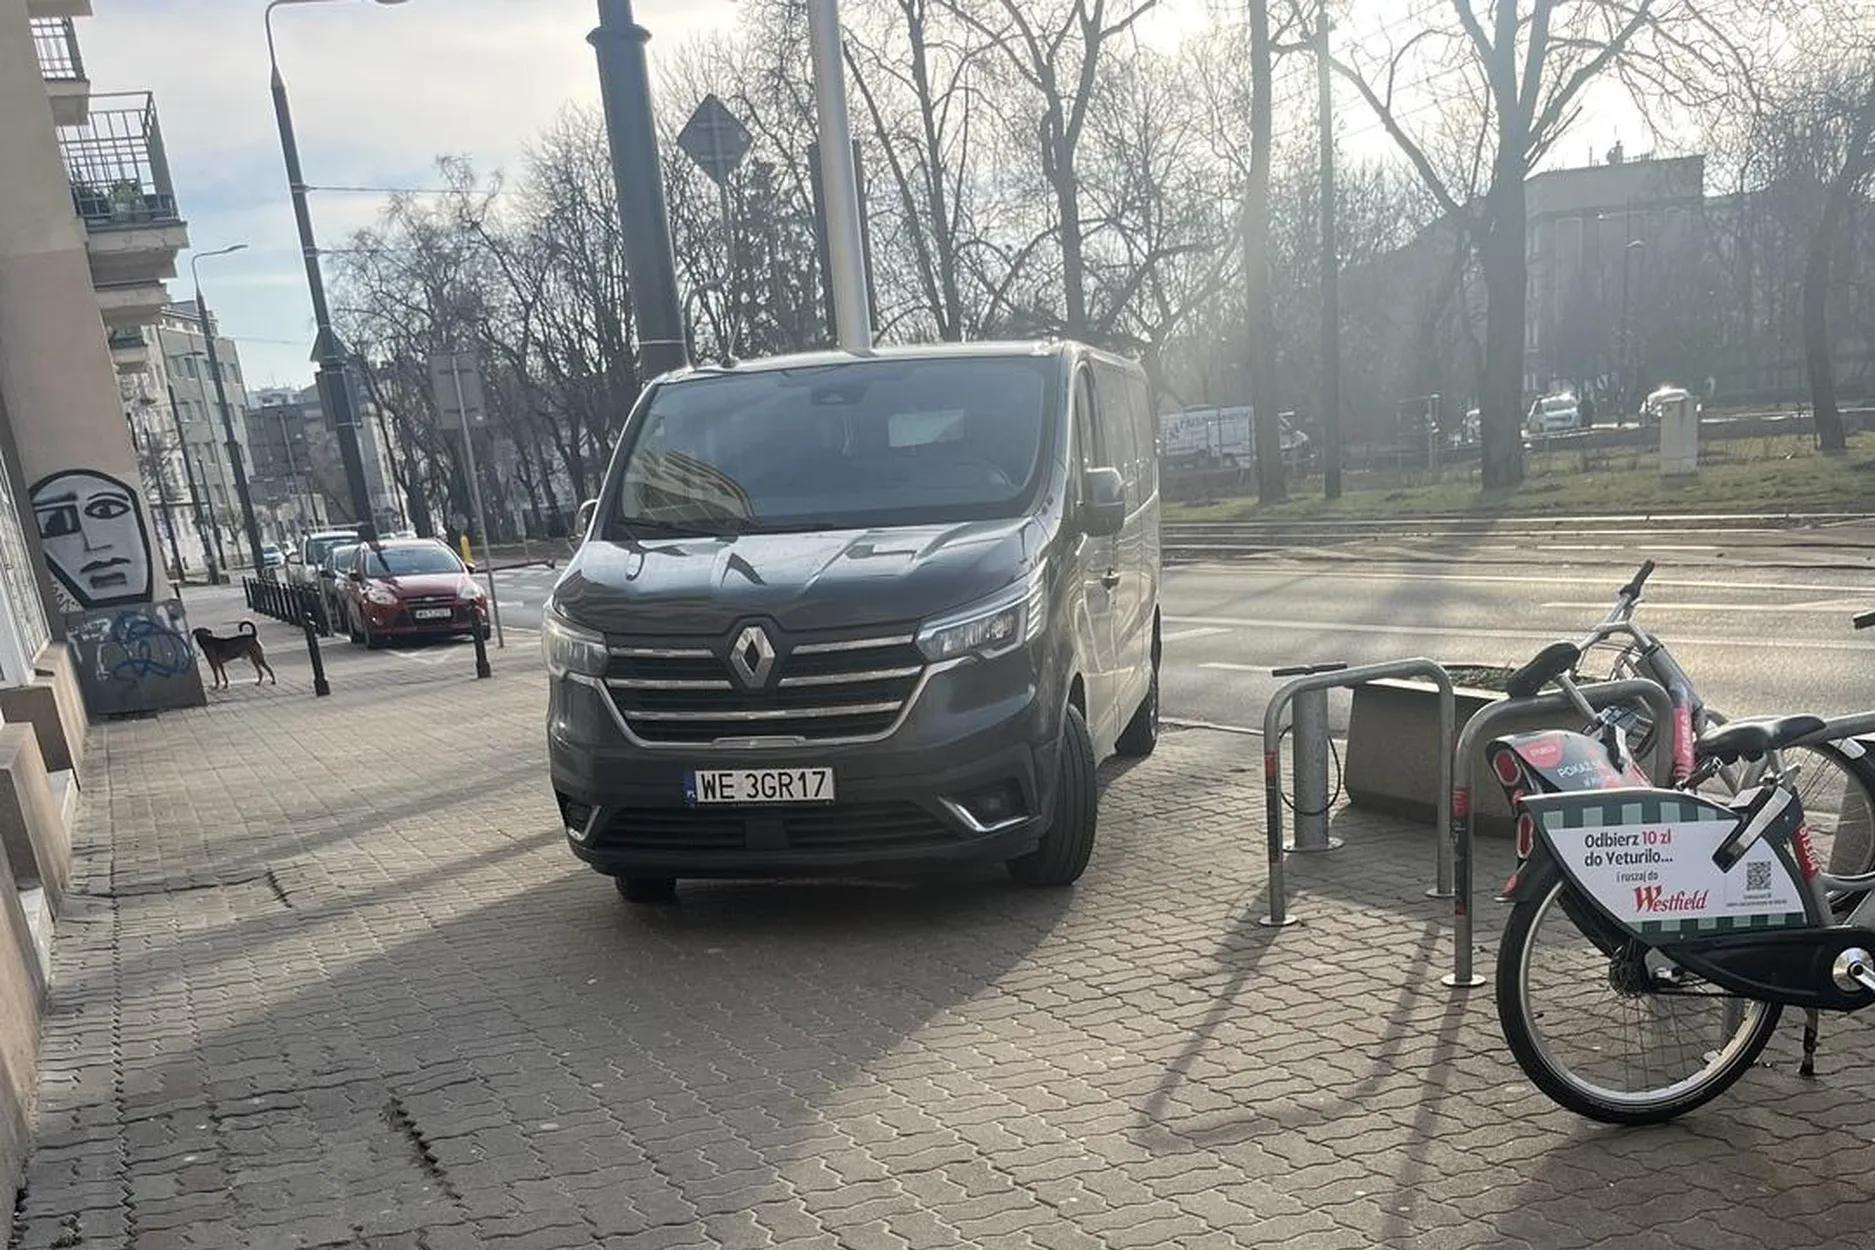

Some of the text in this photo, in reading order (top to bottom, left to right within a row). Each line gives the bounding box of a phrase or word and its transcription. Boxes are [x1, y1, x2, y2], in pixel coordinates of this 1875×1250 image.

[701, 771, 826, 799] WE 3GR17
[1584, 832, 1639, 848] Odbierz
[1642, 830, 1657, 845] 10
[1584, 848, 1673, 867] do Veturilo...
[1648, 870, 1659, 881] do
[1633, 885, 1709, 912] Westfield
